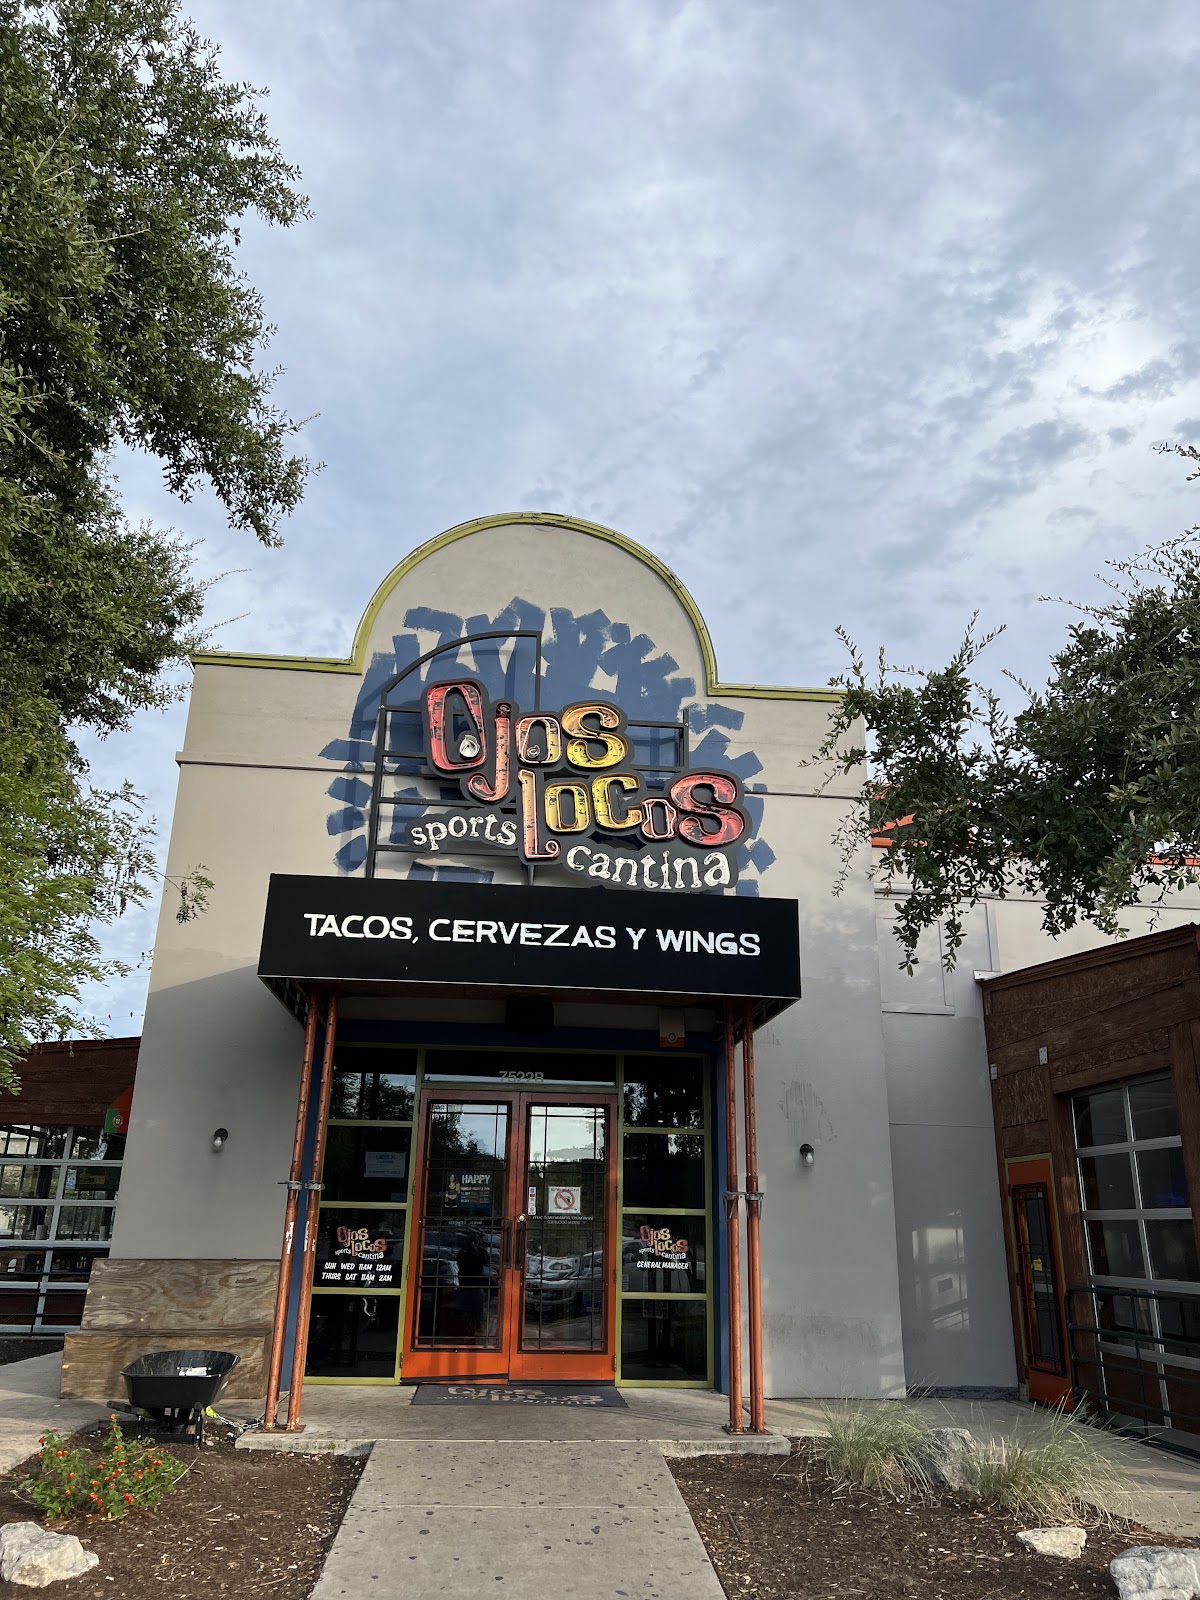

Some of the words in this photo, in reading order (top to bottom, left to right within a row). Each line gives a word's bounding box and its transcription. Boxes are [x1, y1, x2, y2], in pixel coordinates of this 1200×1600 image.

[410, 813, 517, 851] sports
[566, 845, 731, 890] cantina
[303, 913, 419, 944] TACOS,
[428, 918, 616, 949] CERVEZAS
[626, 927, 647, 951] Y
[656, 928, 761, 956] WINGS
[499, 1071, 544, 1084] 7522B
[461, 1174, 491, 1184] HAPPY
[340, 1262, 355, 1270] WED
[375, 1264, 392, 1272] 12AM
[636, 1261, 662, 1269] GENERAL
[662, 1261, 689, 1270] MANAGER
[345, 1273, 358, 1281] SAT
[378, 1274, 393, 1282] 2AM
